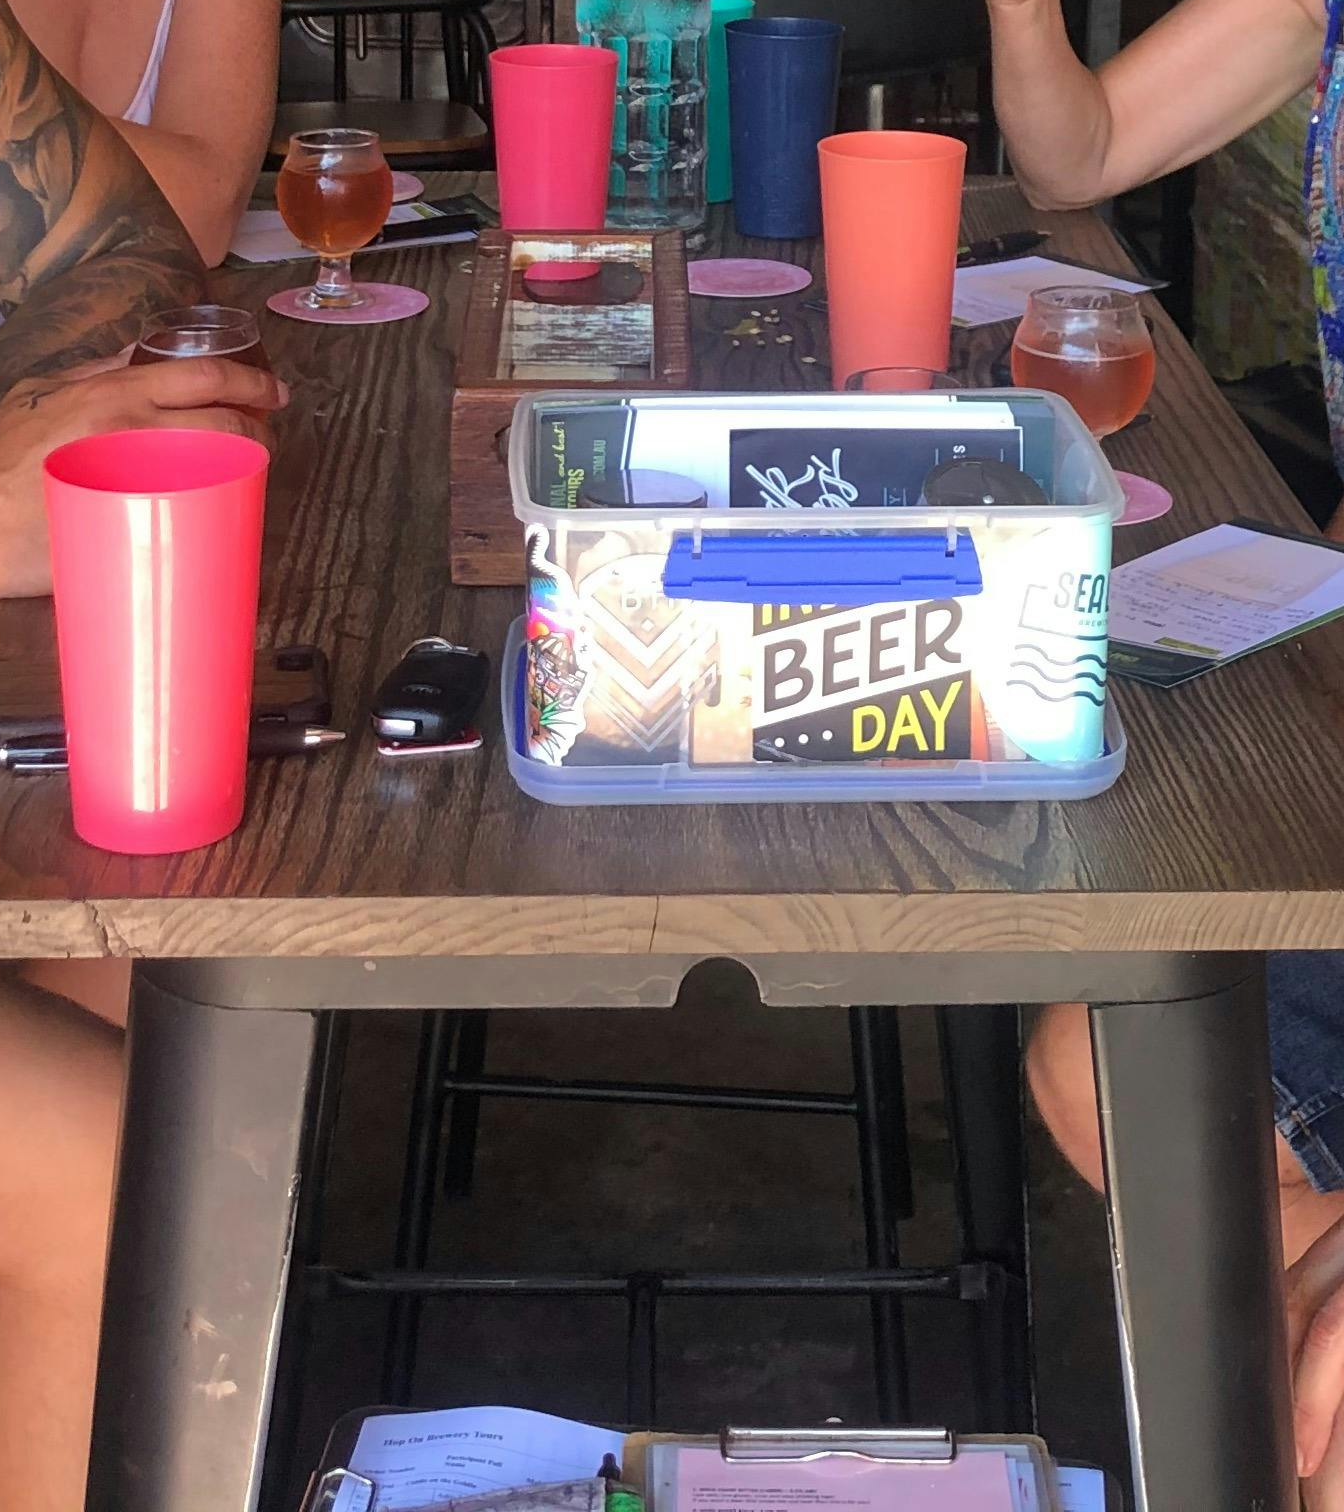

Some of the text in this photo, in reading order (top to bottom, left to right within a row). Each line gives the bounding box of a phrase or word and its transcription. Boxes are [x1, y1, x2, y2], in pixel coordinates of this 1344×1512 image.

[764, 598, 963, 713] BEER
[852, 680, 963, 752] DAY
[383, 1437, 405, 1447] Hop
[426, 1431, 470, 1443] Brewery
[474, 1430, 503, 1441] Tours
